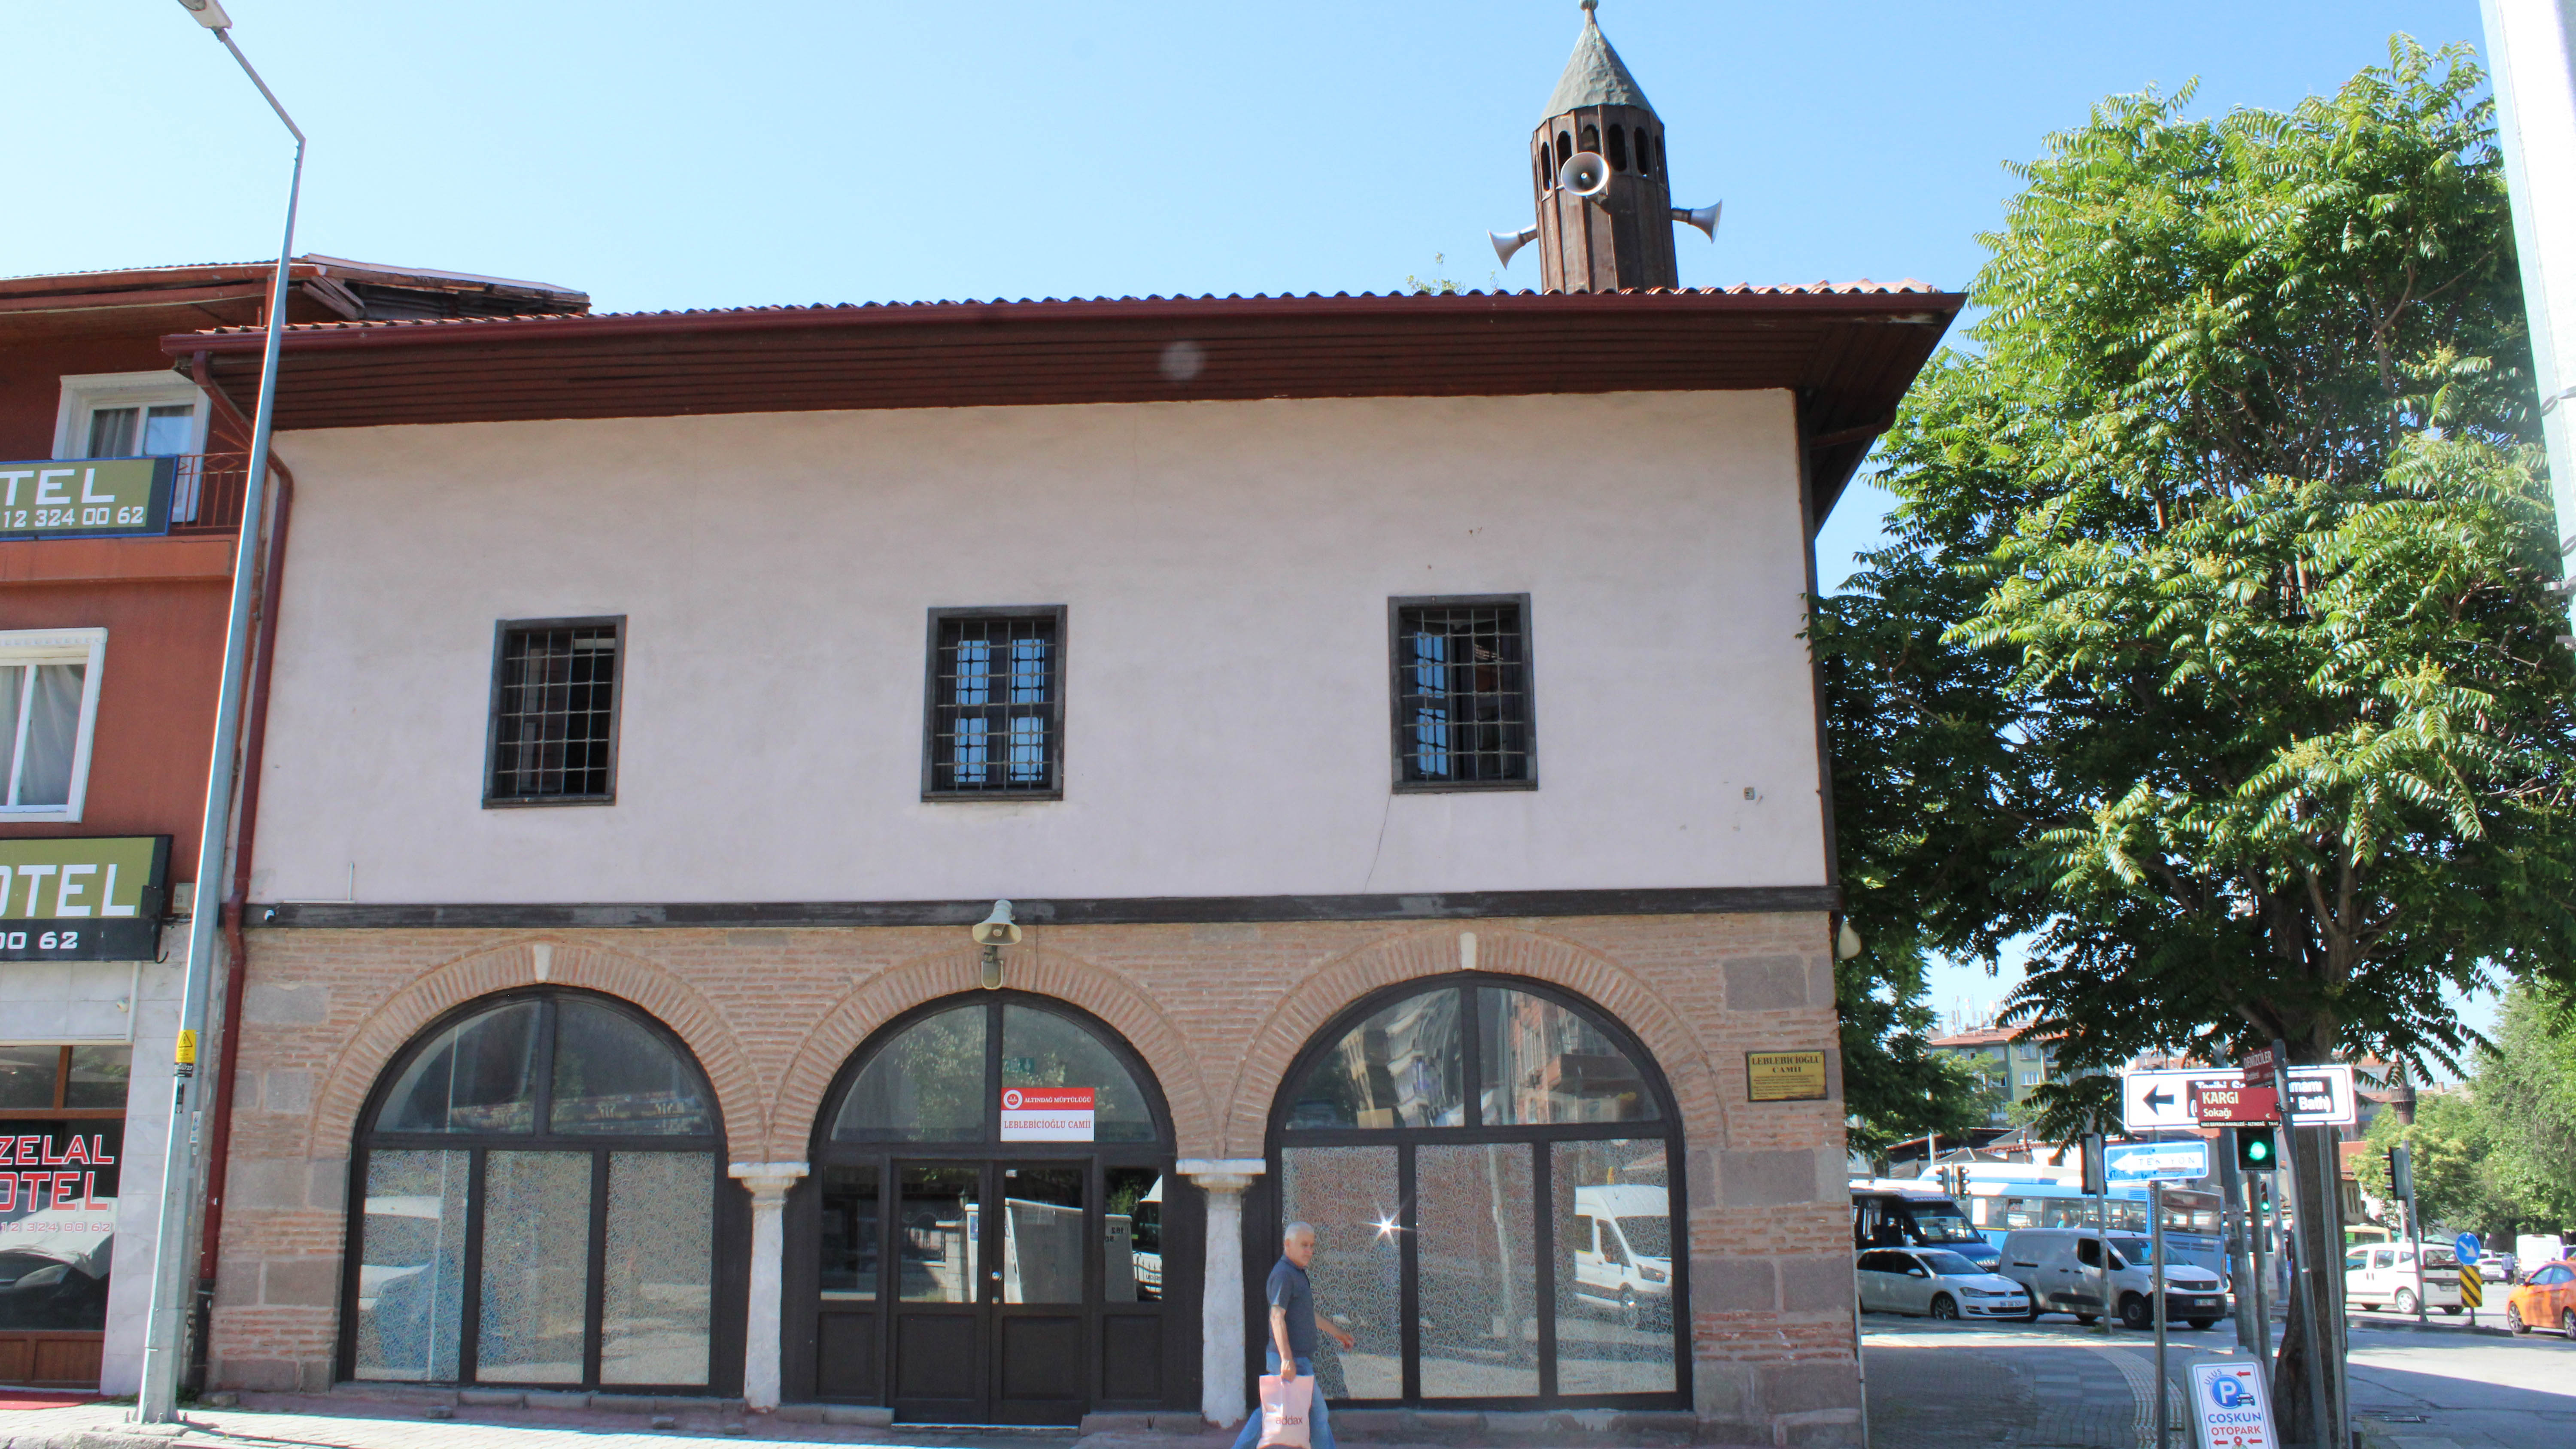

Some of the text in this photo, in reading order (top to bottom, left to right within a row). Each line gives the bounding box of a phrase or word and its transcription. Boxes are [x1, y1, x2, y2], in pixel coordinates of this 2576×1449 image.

[35, 508, 75, 527] 324
[82, 507, 109, 526] 00
[117, 506, 144, 524] 62
[39, 931, 78, 949] 62
[2202, 1091, 2239, 1104] KARGI
[2203, 1107, 2232, 1119] Sokağı
[1004, 1118, 1091, 1129] LEBLEBİCİOĞLU CAMİİ
[27, 1222, 58, 1232] 324
[64, 1222, 84, 1232] 00
[91, 1222, 111, 1232] 62
[2204, 1368, 2222, 1385] ULUS
[2219, 1381, 2237, 1404] P
[1276, 1416, 1303, 1425] addax
[2211, 1426, 2261, 1436] OTOPARK
